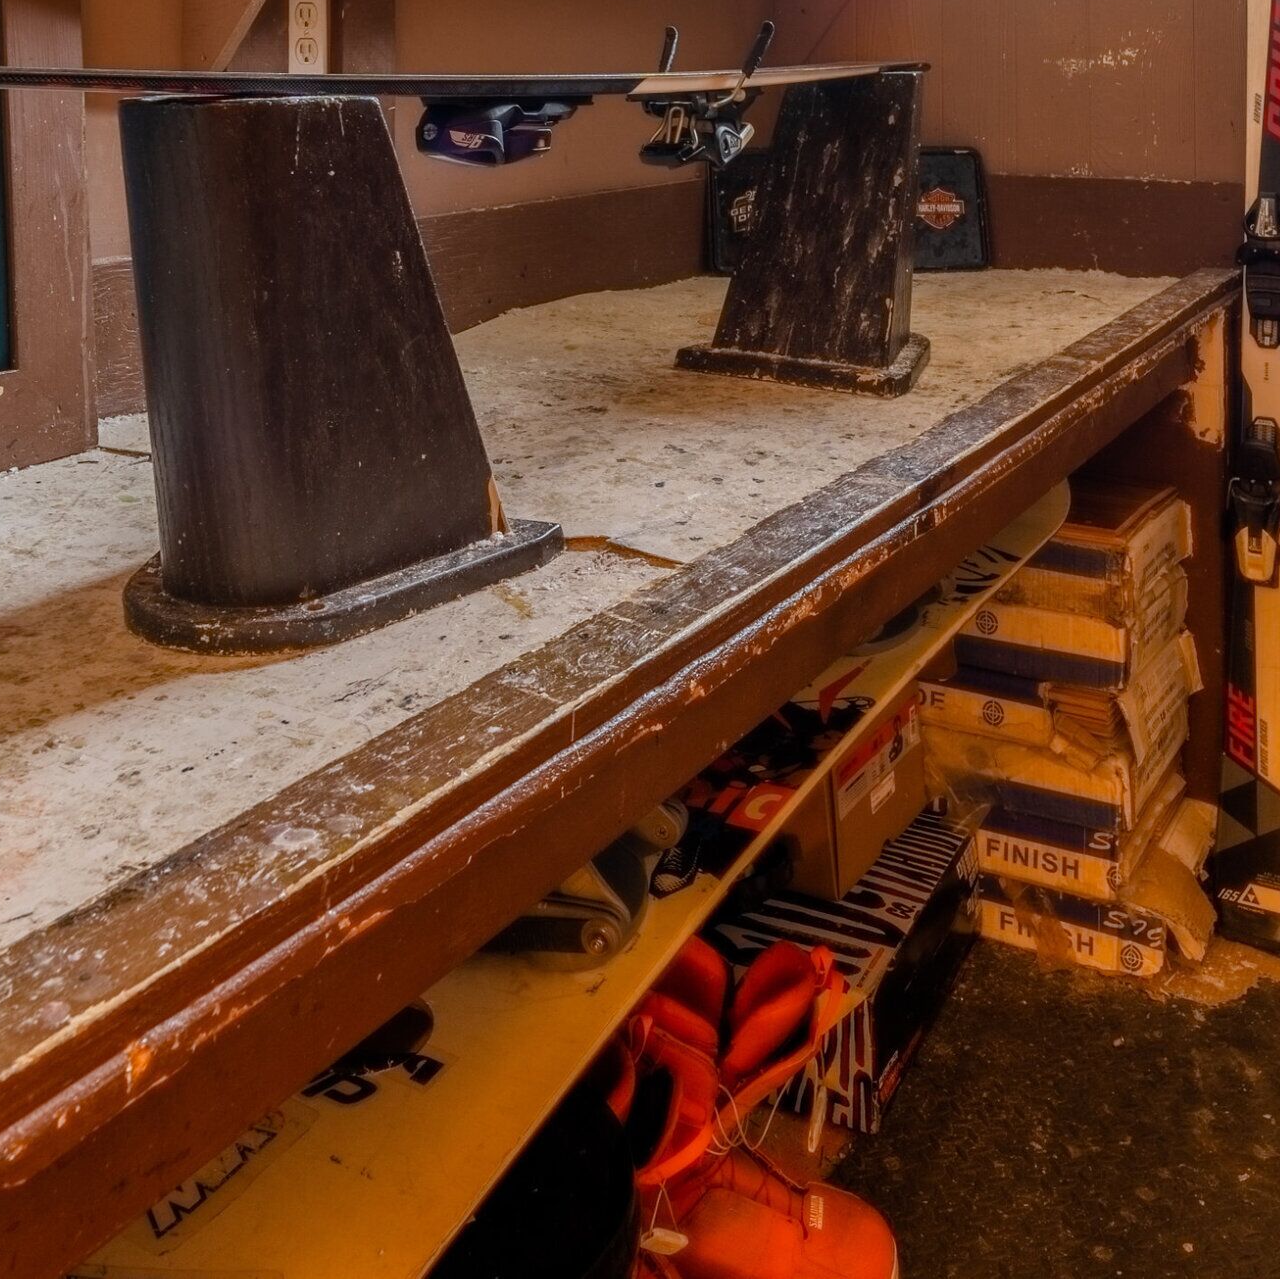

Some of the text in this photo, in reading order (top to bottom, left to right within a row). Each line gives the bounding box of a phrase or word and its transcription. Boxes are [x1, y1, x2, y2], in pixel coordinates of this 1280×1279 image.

[1227, 682, 1256, 770] FIRE
[986, 837, 1080, 880] FINISH
[1218, 887, 1240, 902] 165
